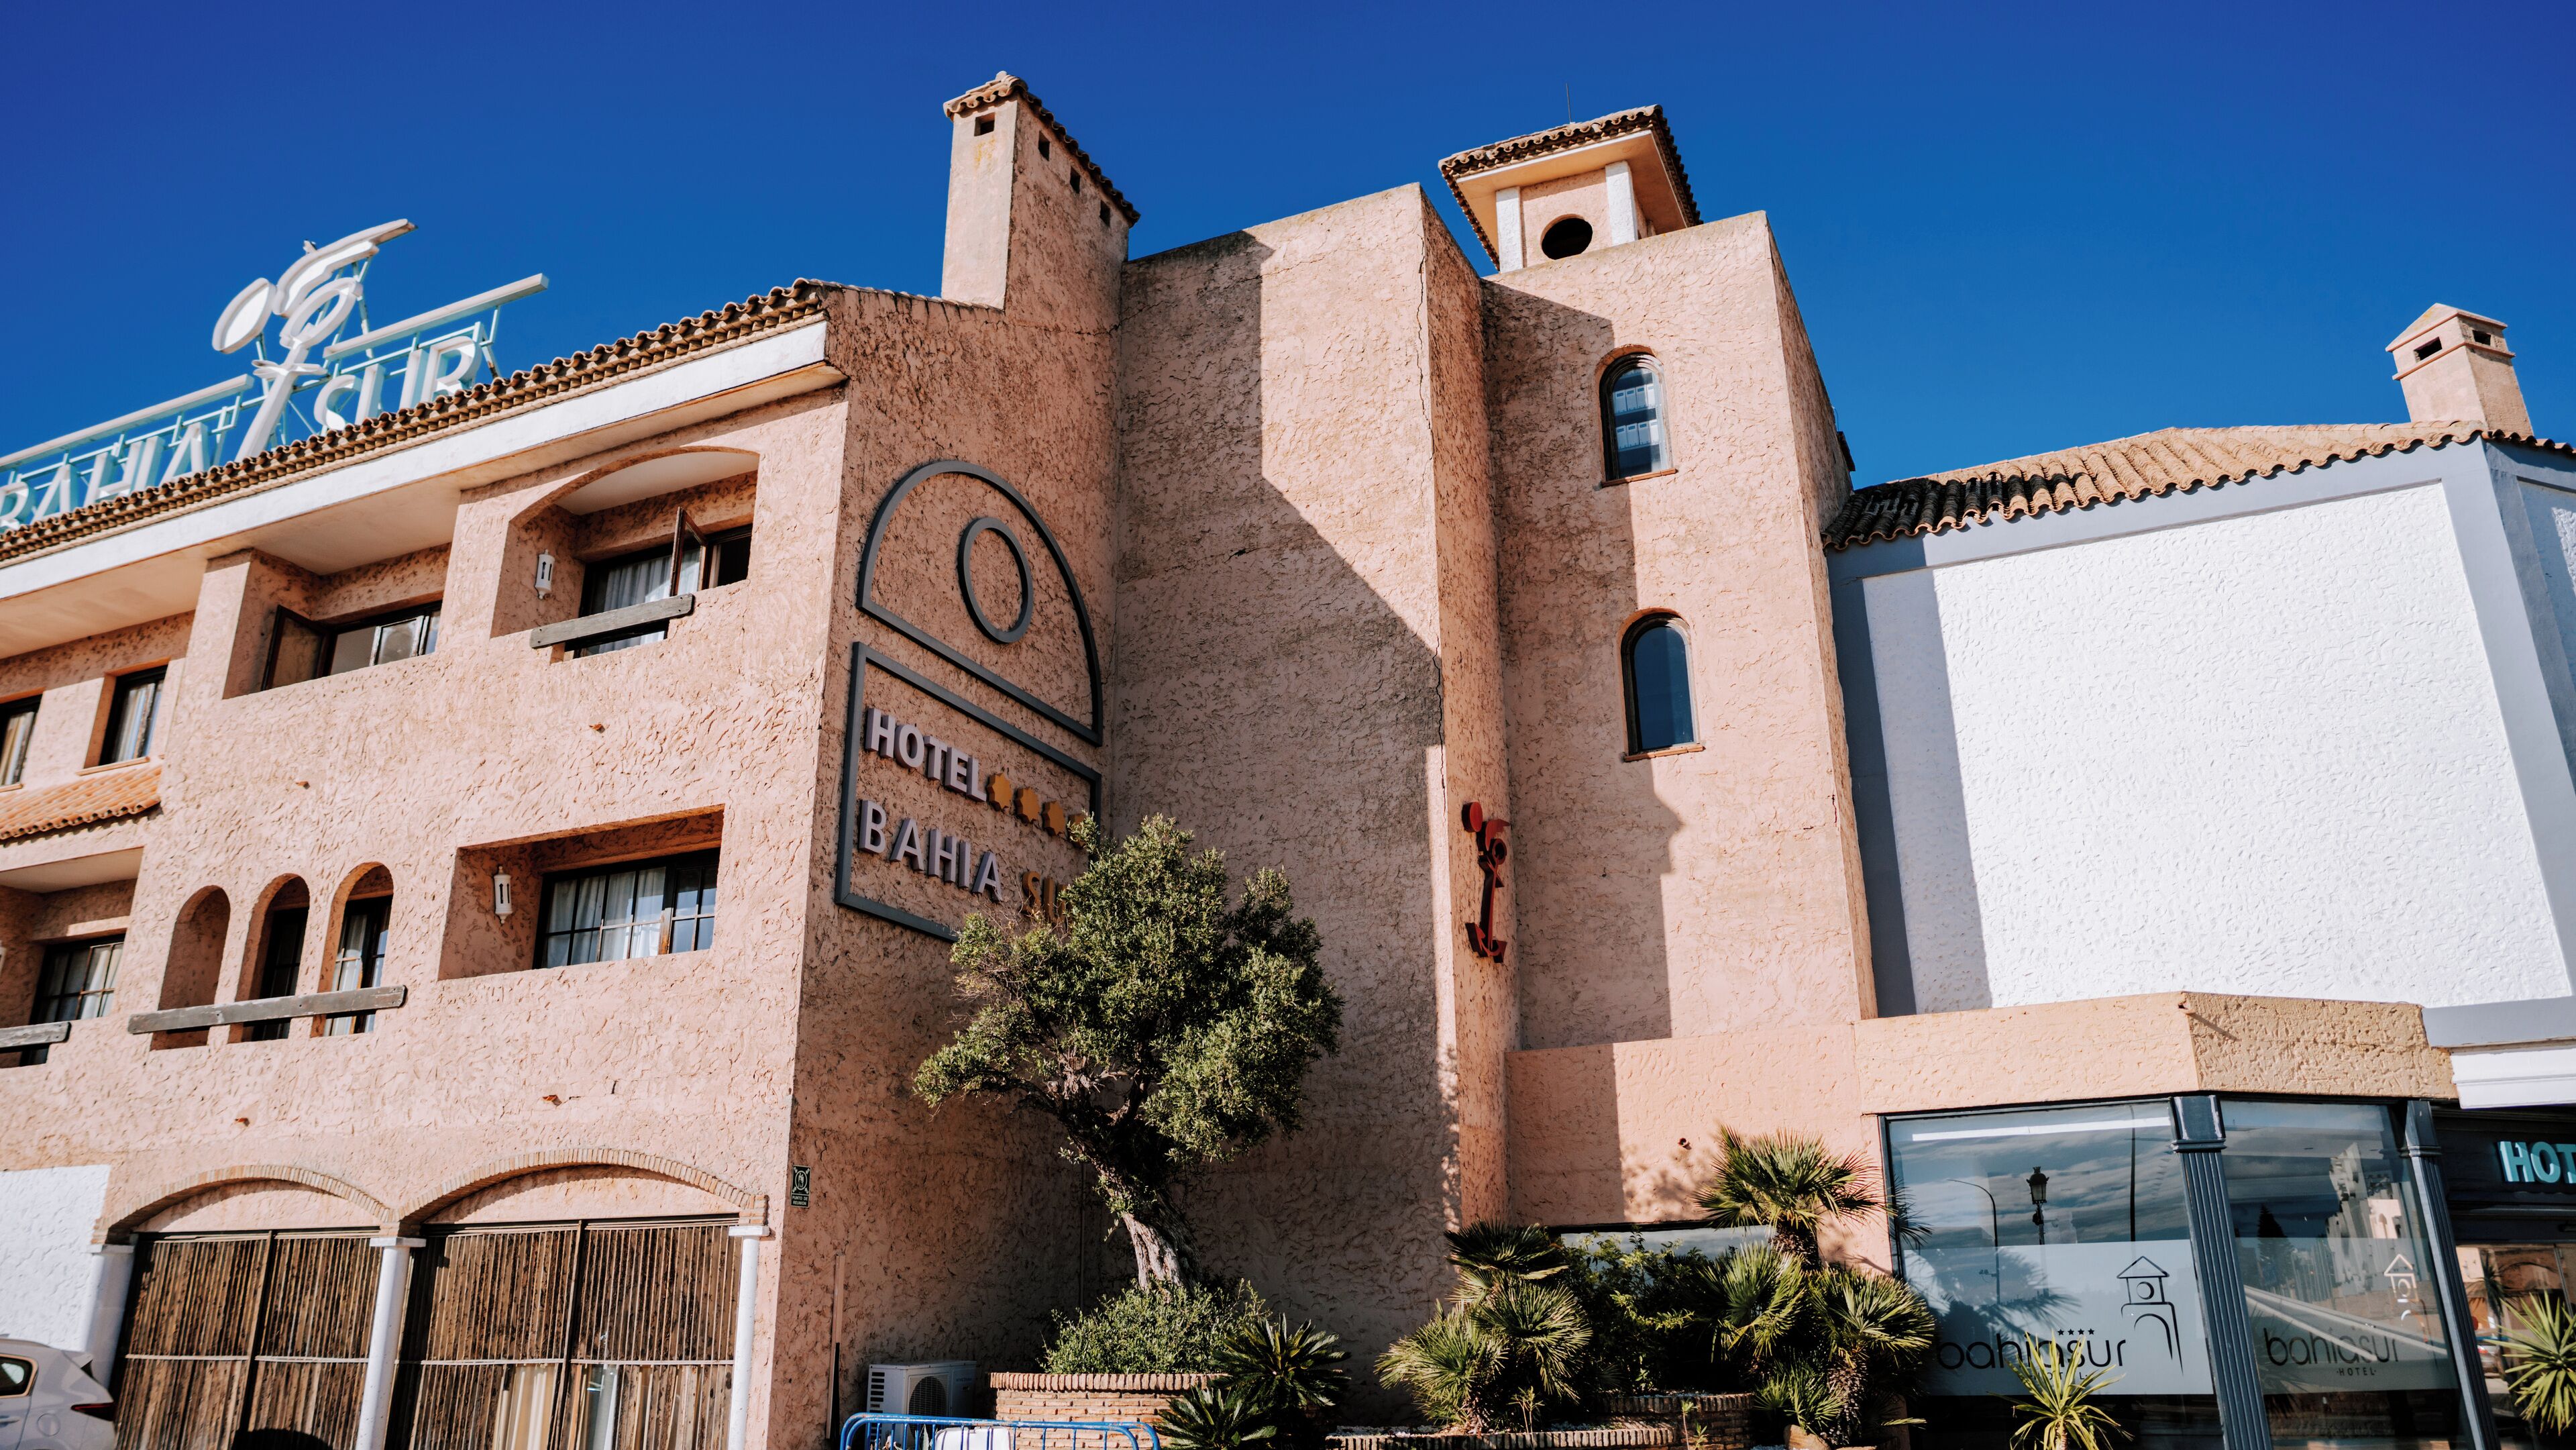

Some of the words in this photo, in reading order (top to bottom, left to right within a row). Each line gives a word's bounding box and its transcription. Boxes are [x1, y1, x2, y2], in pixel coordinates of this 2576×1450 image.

[313, 335, 482, 431] SUR
[865, 707, 987, 802] HOTEL
[859, 800, 1003, 902] BAHIA
